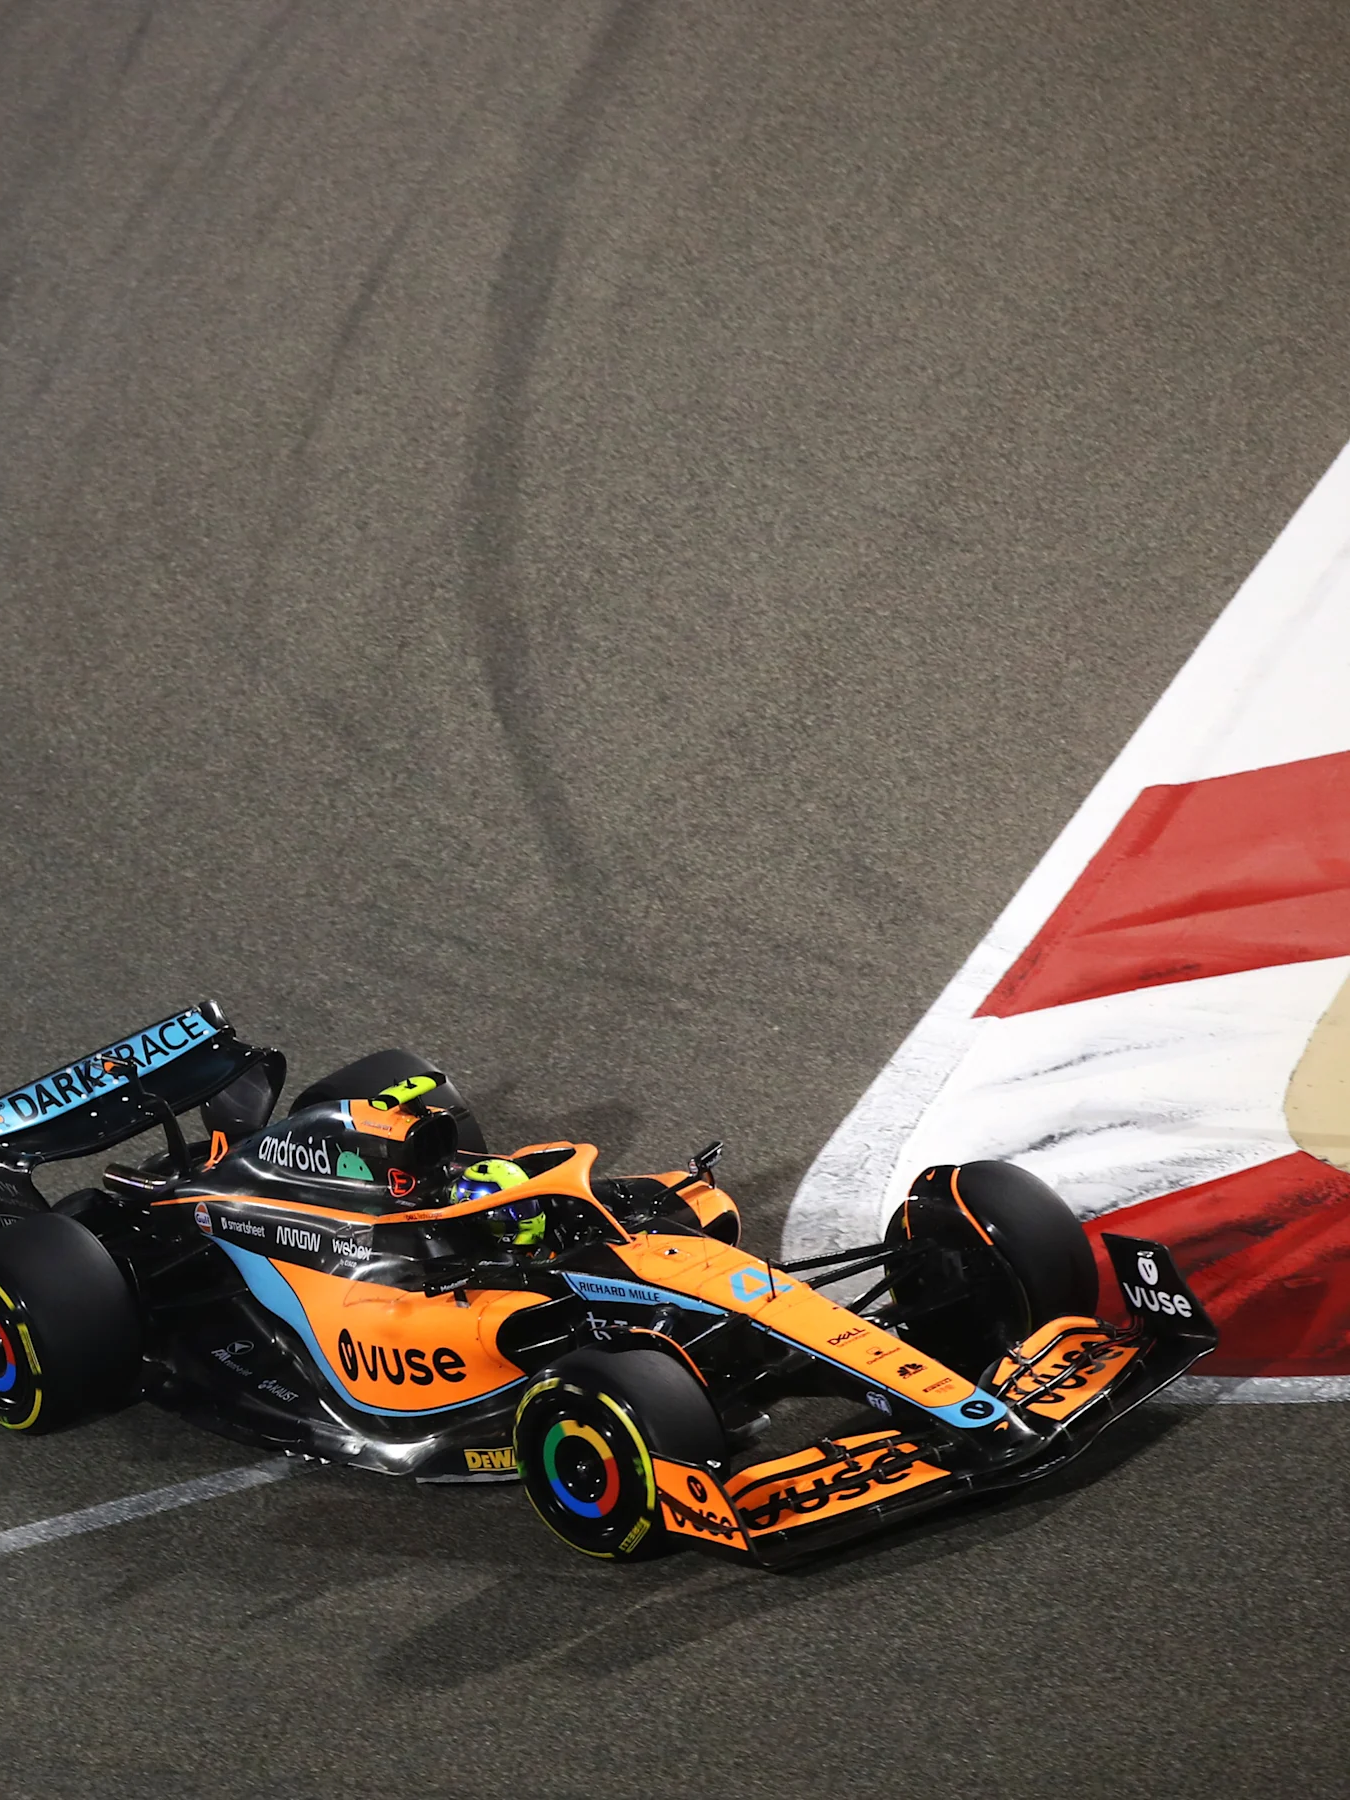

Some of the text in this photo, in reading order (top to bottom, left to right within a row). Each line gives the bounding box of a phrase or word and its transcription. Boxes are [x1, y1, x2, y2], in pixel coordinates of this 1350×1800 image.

[258, 1131, 332, 1175] android
[227, 1219, 266, 1238] smartsheet
[332, 1237, 372, 1261] webex
[578, 1281, 660, 1303] RICHARD MILLE
[1122, 1281, 1192, 1318] vuse
[827, 1327, 867, 1346] DELL
[356, 1340, 468, 1386] vuse
[268, 1384, 300, 1403] KAUST
